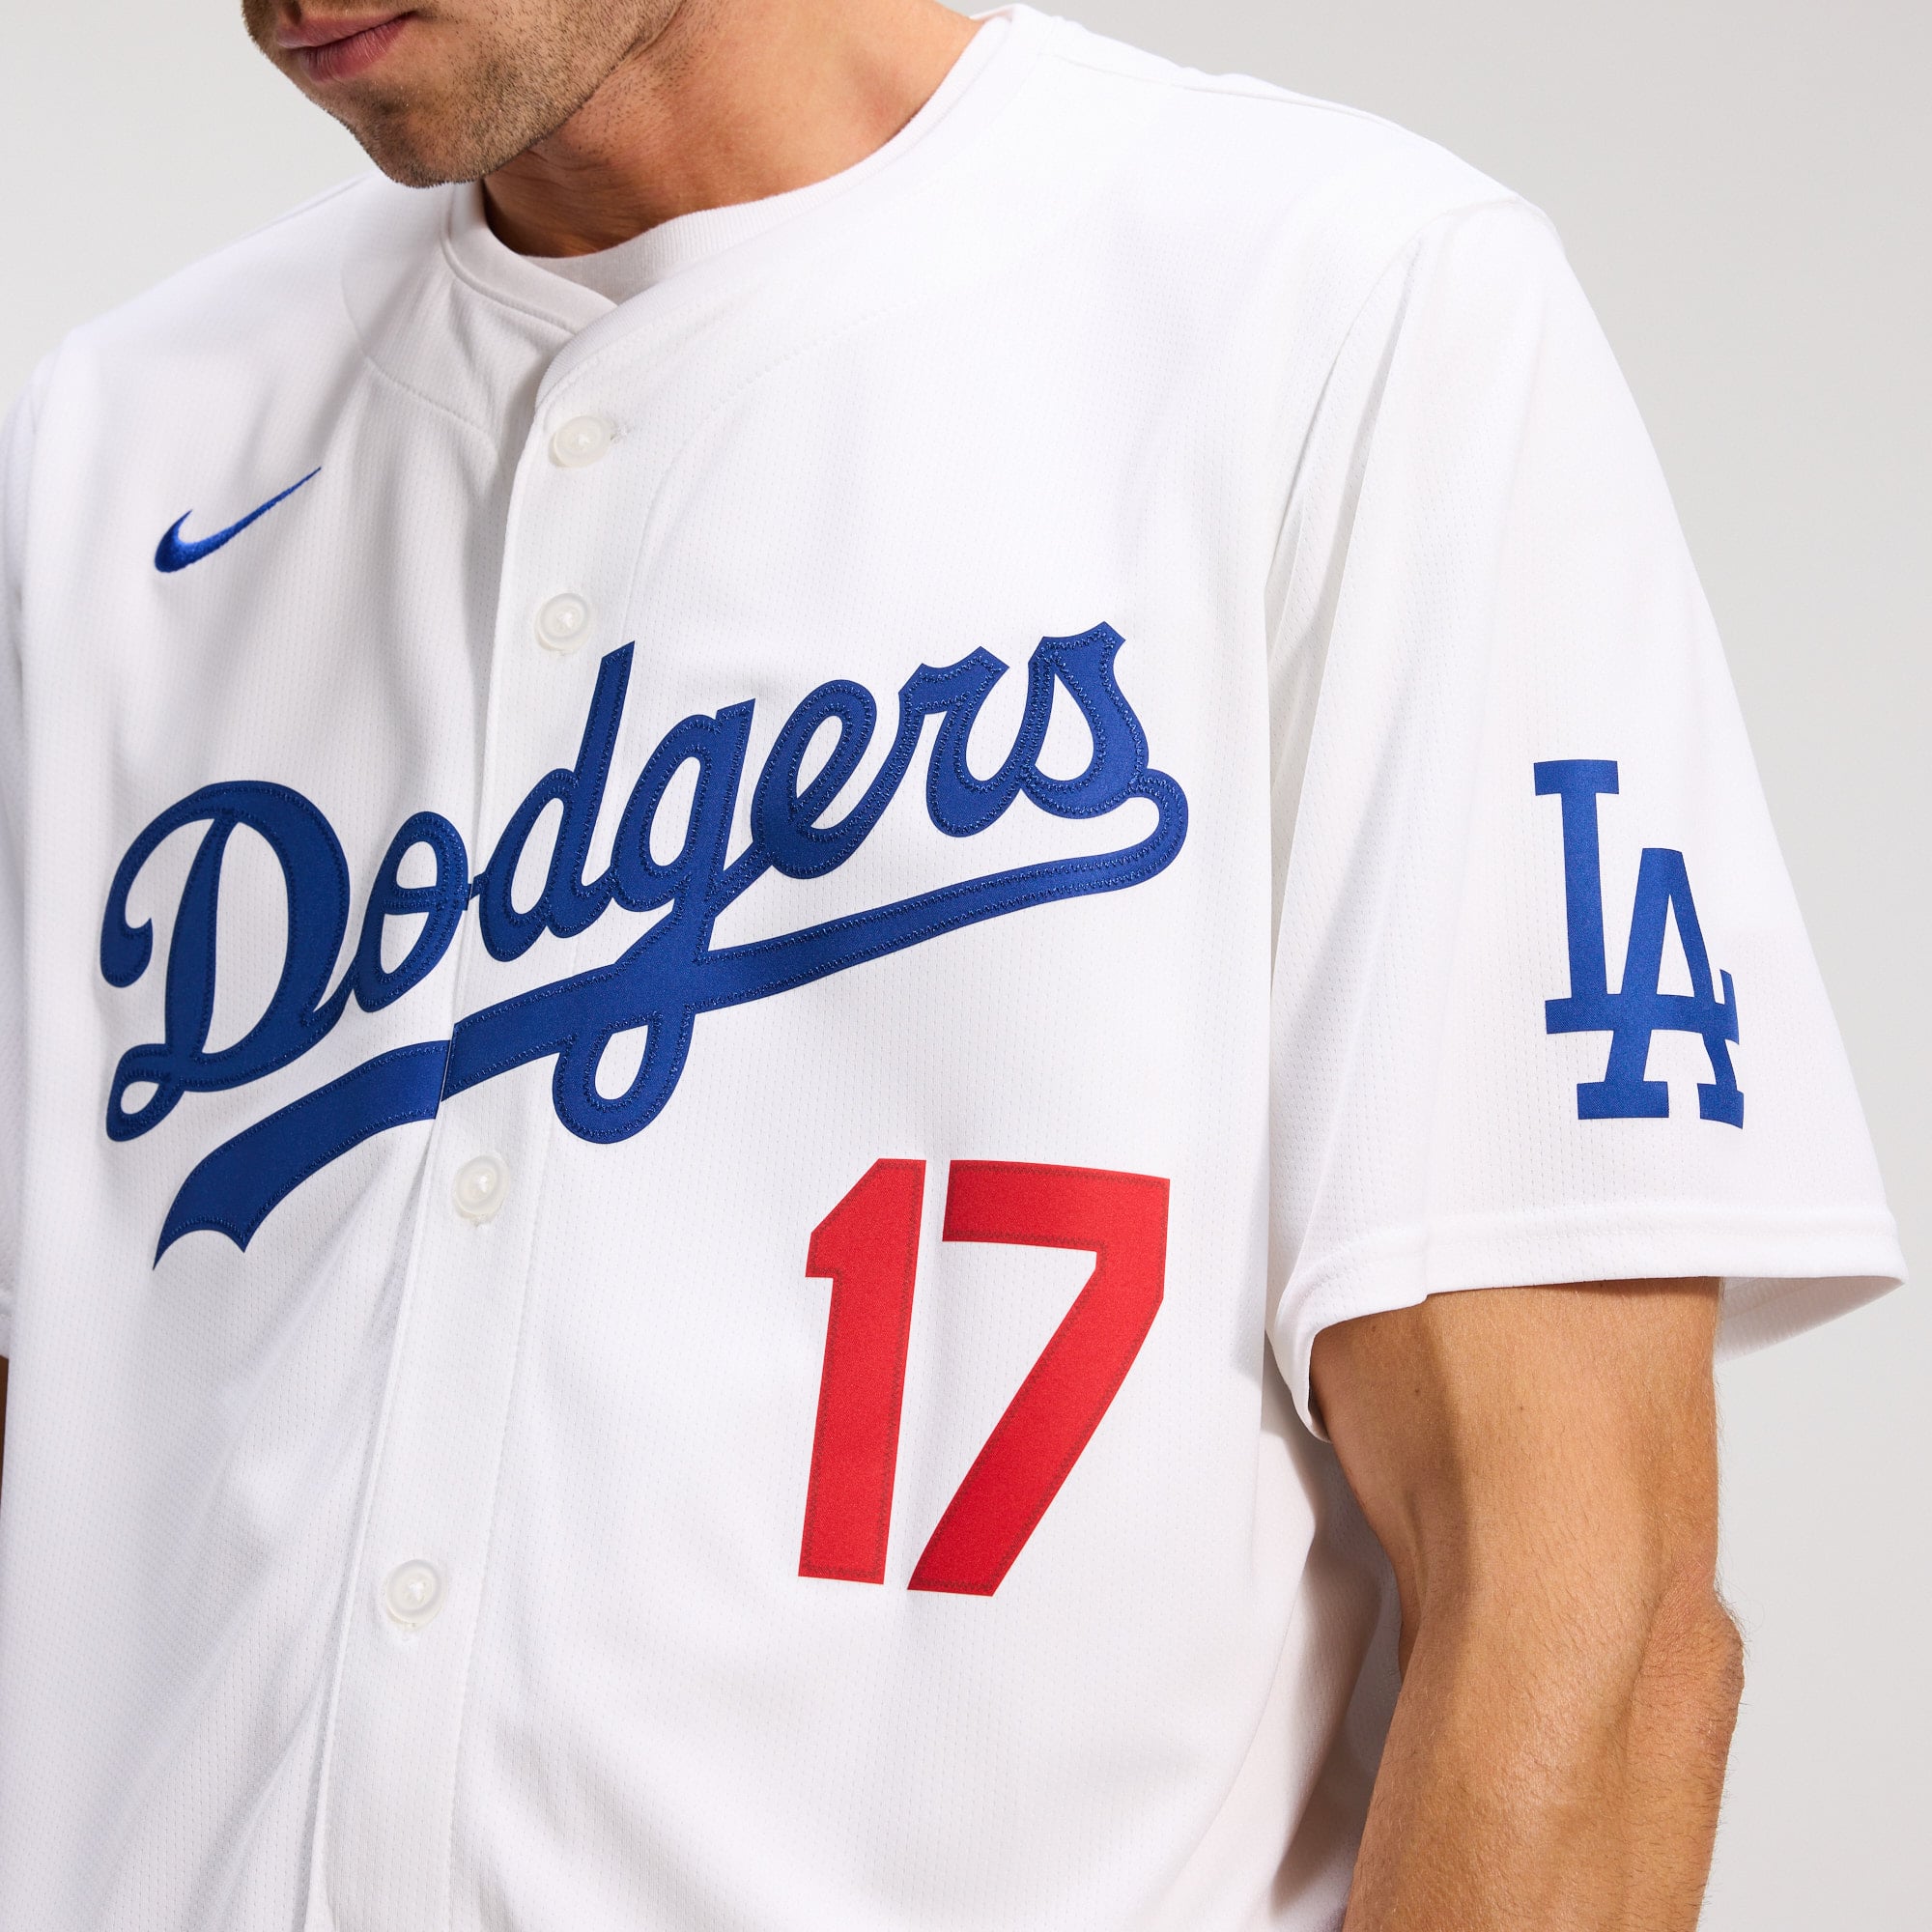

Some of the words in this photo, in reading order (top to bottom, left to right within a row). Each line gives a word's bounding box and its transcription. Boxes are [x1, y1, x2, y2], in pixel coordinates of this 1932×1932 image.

[100, 621, 1189, 1145] Dodgers
[1533, 759, 1744, 1128] LA
[798, 1158, 1169, 1597] 17
